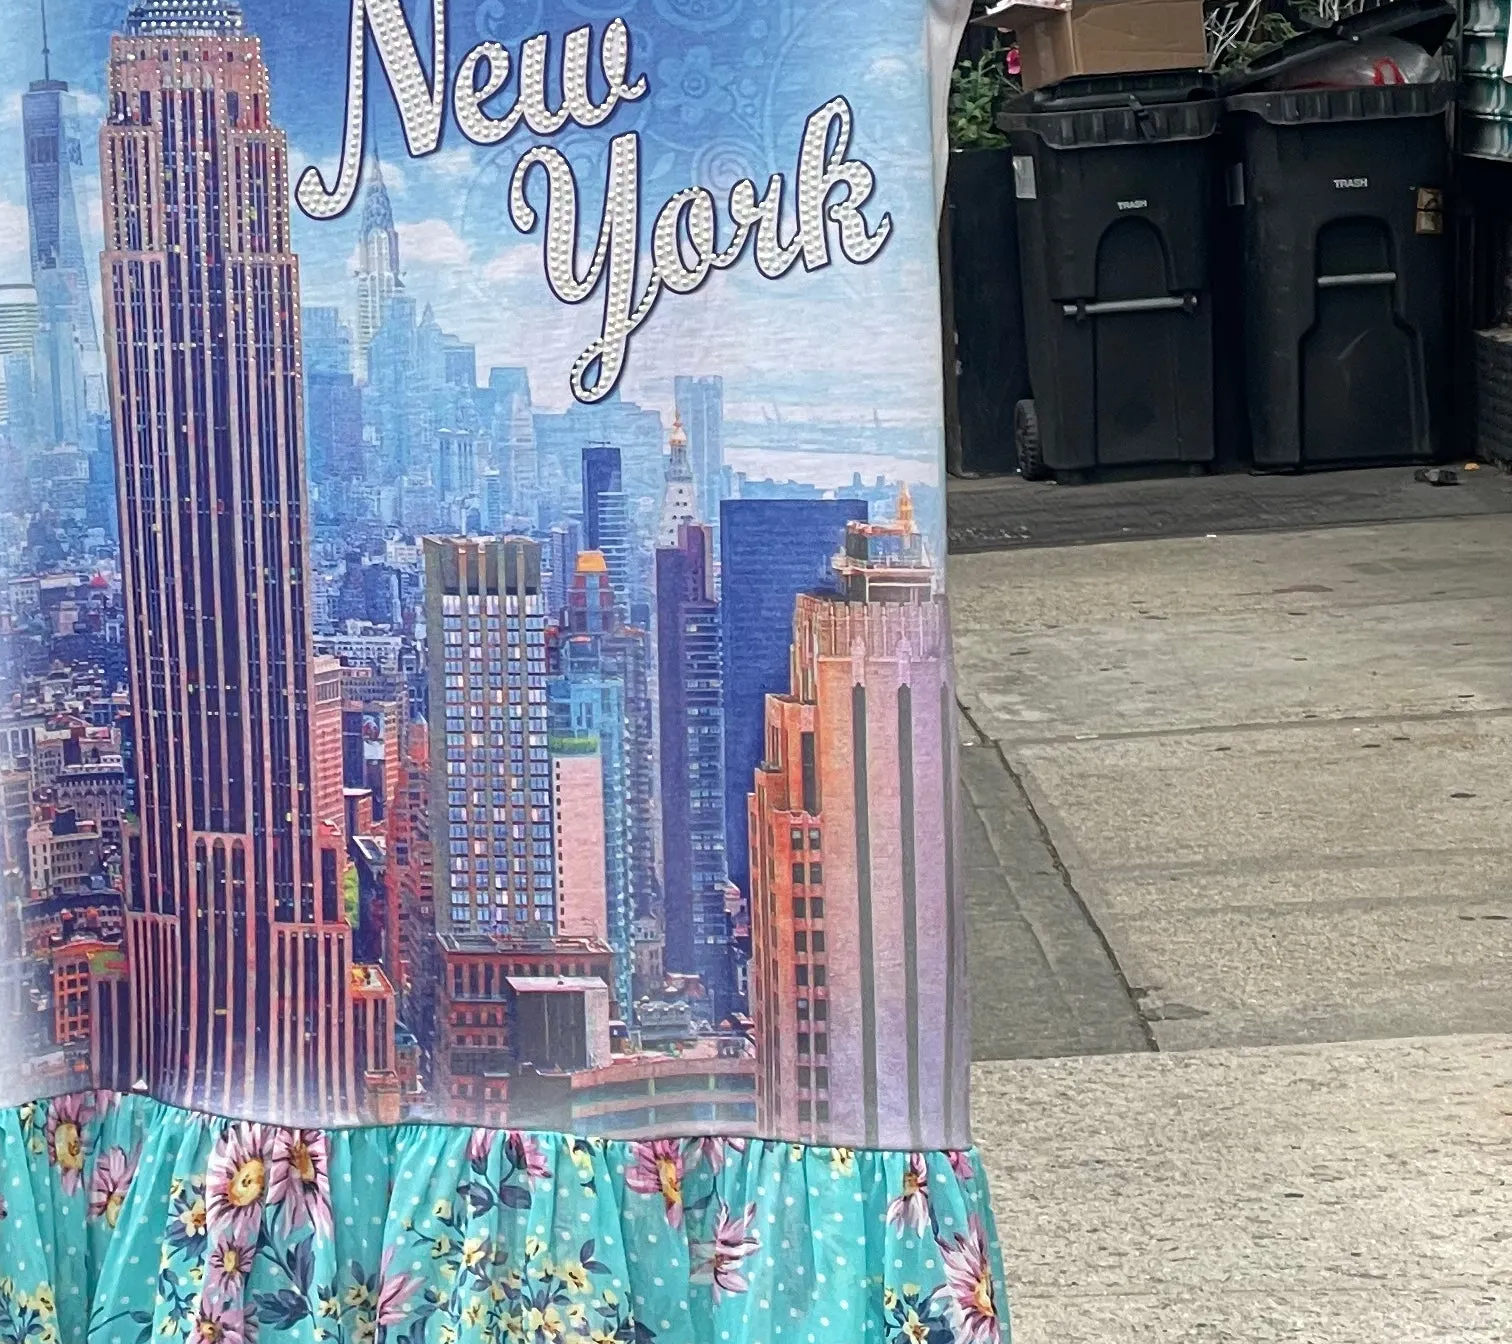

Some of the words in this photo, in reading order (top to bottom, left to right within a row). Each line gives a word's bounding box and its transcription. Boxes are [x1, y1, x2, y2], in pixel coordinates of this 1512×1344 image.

[1333, 178, 1368, 189] TRASH
[1117, 199, 1147, 210] TRASH
[507, 95, 892, 404] York
